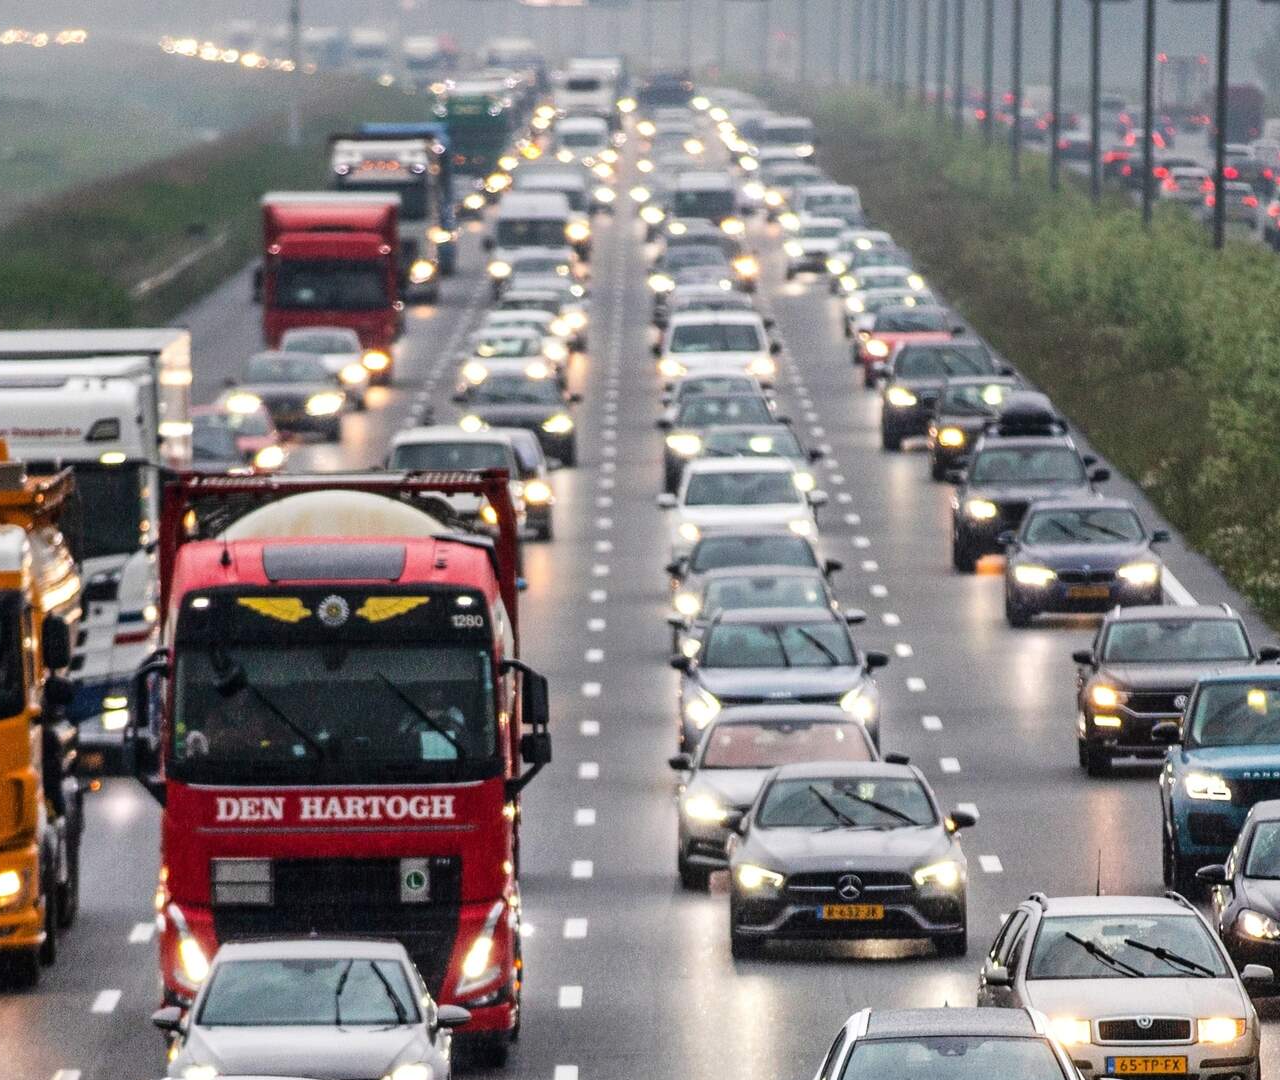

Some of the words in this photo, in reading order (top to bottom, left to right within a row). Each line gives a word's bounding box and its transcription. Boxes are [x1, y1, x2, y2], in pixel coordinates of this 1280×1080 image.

[452, 614, 484, 628] 1280
[216, 797, 285, 821] DEN
[299, 796, 455, 820] HARTOGH
[1119, 1058, 1181, 1073] 65-TP-FX
